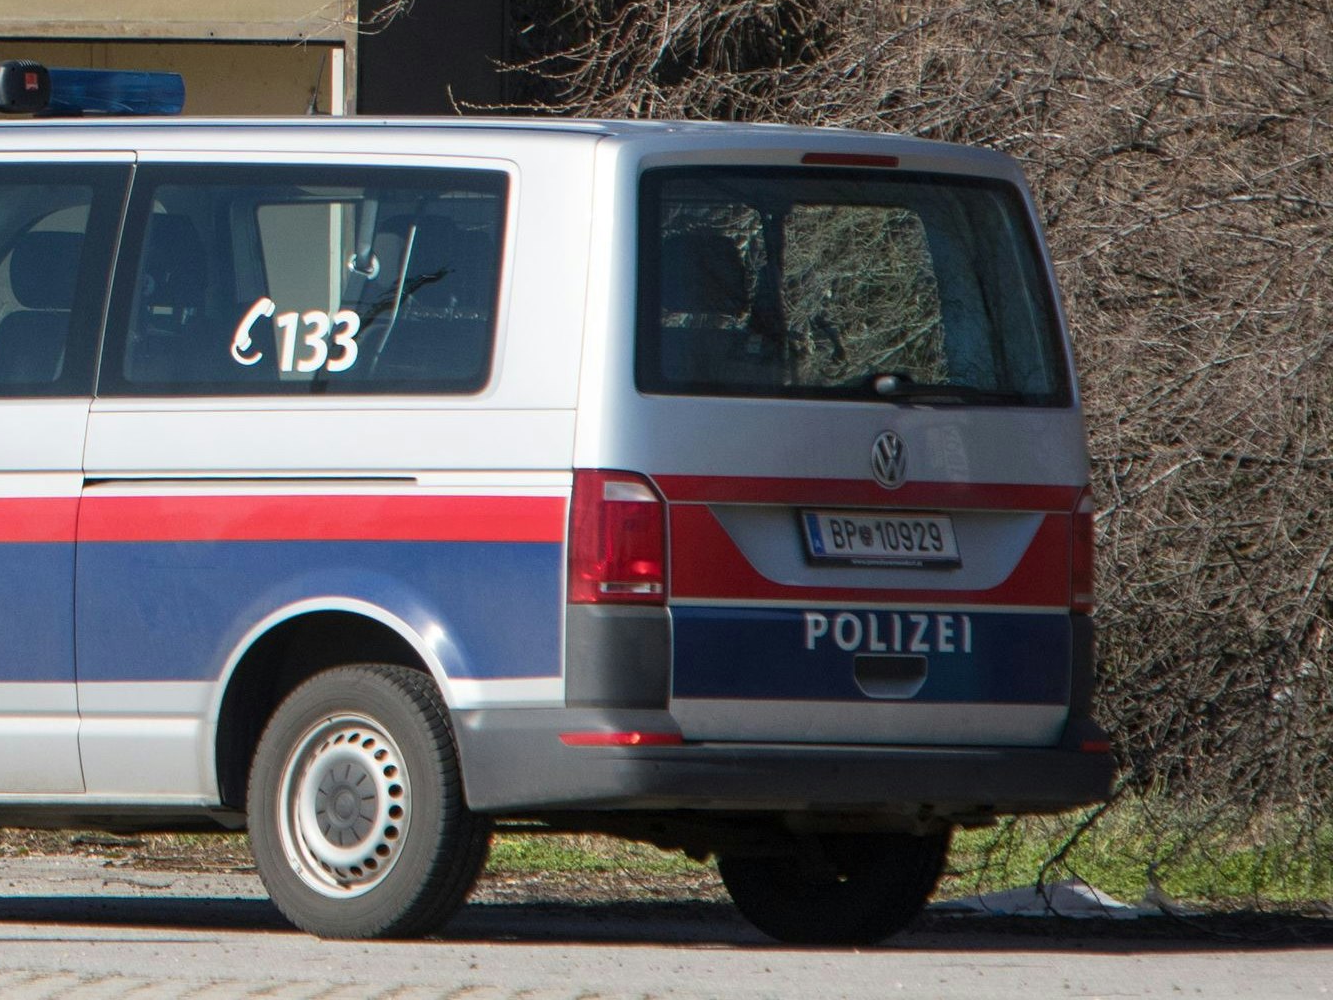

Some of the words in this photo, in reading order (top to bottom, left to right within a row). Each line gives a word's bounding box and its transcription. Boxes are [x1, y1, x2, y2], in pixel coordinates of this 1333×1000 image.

[276, 310, 361, 372] 133
[871, 429, 910, 489] VW
[830, 519, 857, 550] BP
[875, 521, 944, 552] 10929
[805, 611, 972, 653] POLIZEI
